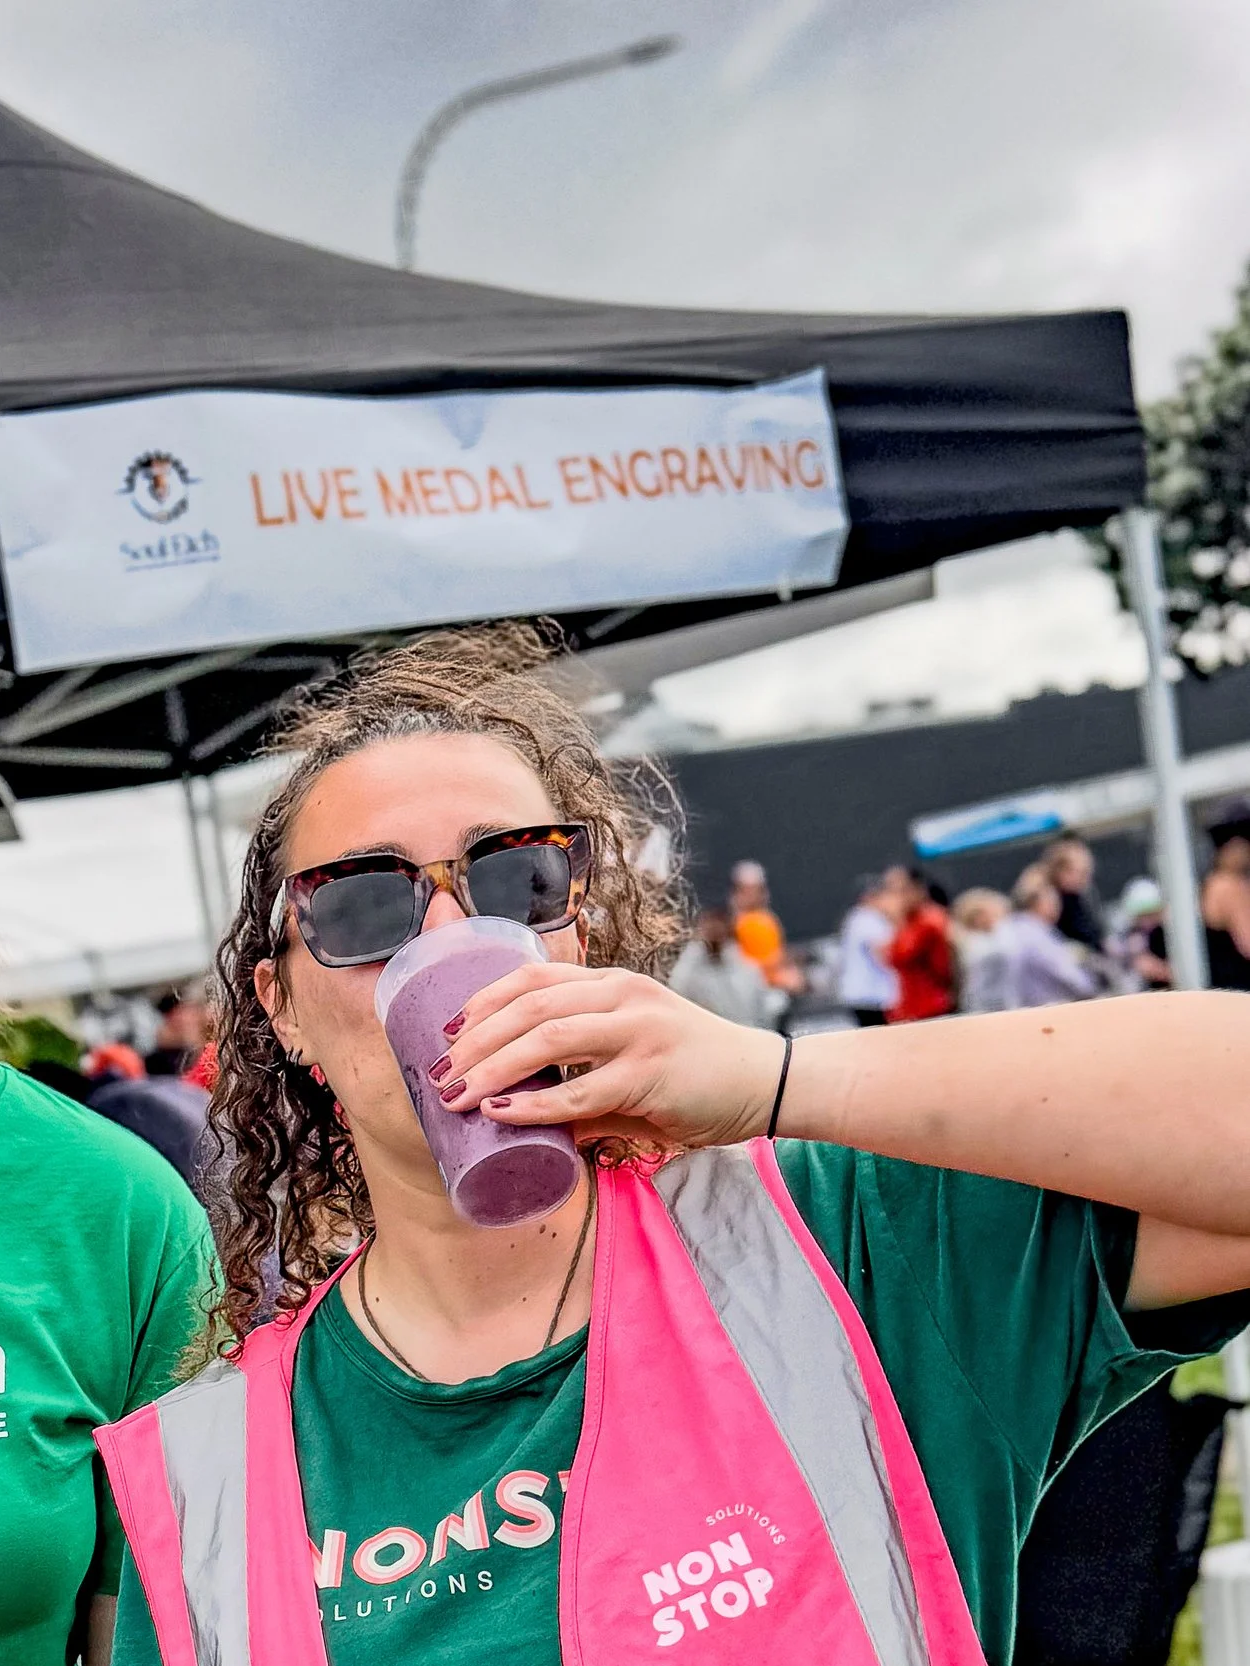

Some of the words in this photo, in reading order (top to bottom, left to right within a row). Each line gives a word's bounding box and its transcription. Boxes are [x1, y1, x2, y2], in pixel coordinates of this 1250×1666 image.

[249, 467, 367, 526] LIVE
[375, 463, 552, 516] MEDAL
[556, 439, 825, 507] ENGRAVING
[705, 1503, 787, 1545] SOLUTIONS
[319, 1570, 494, 1622] LUTIONS
[642, 1531, 753, 1605] NON
[652, 1567, 775, 1647] STOP
